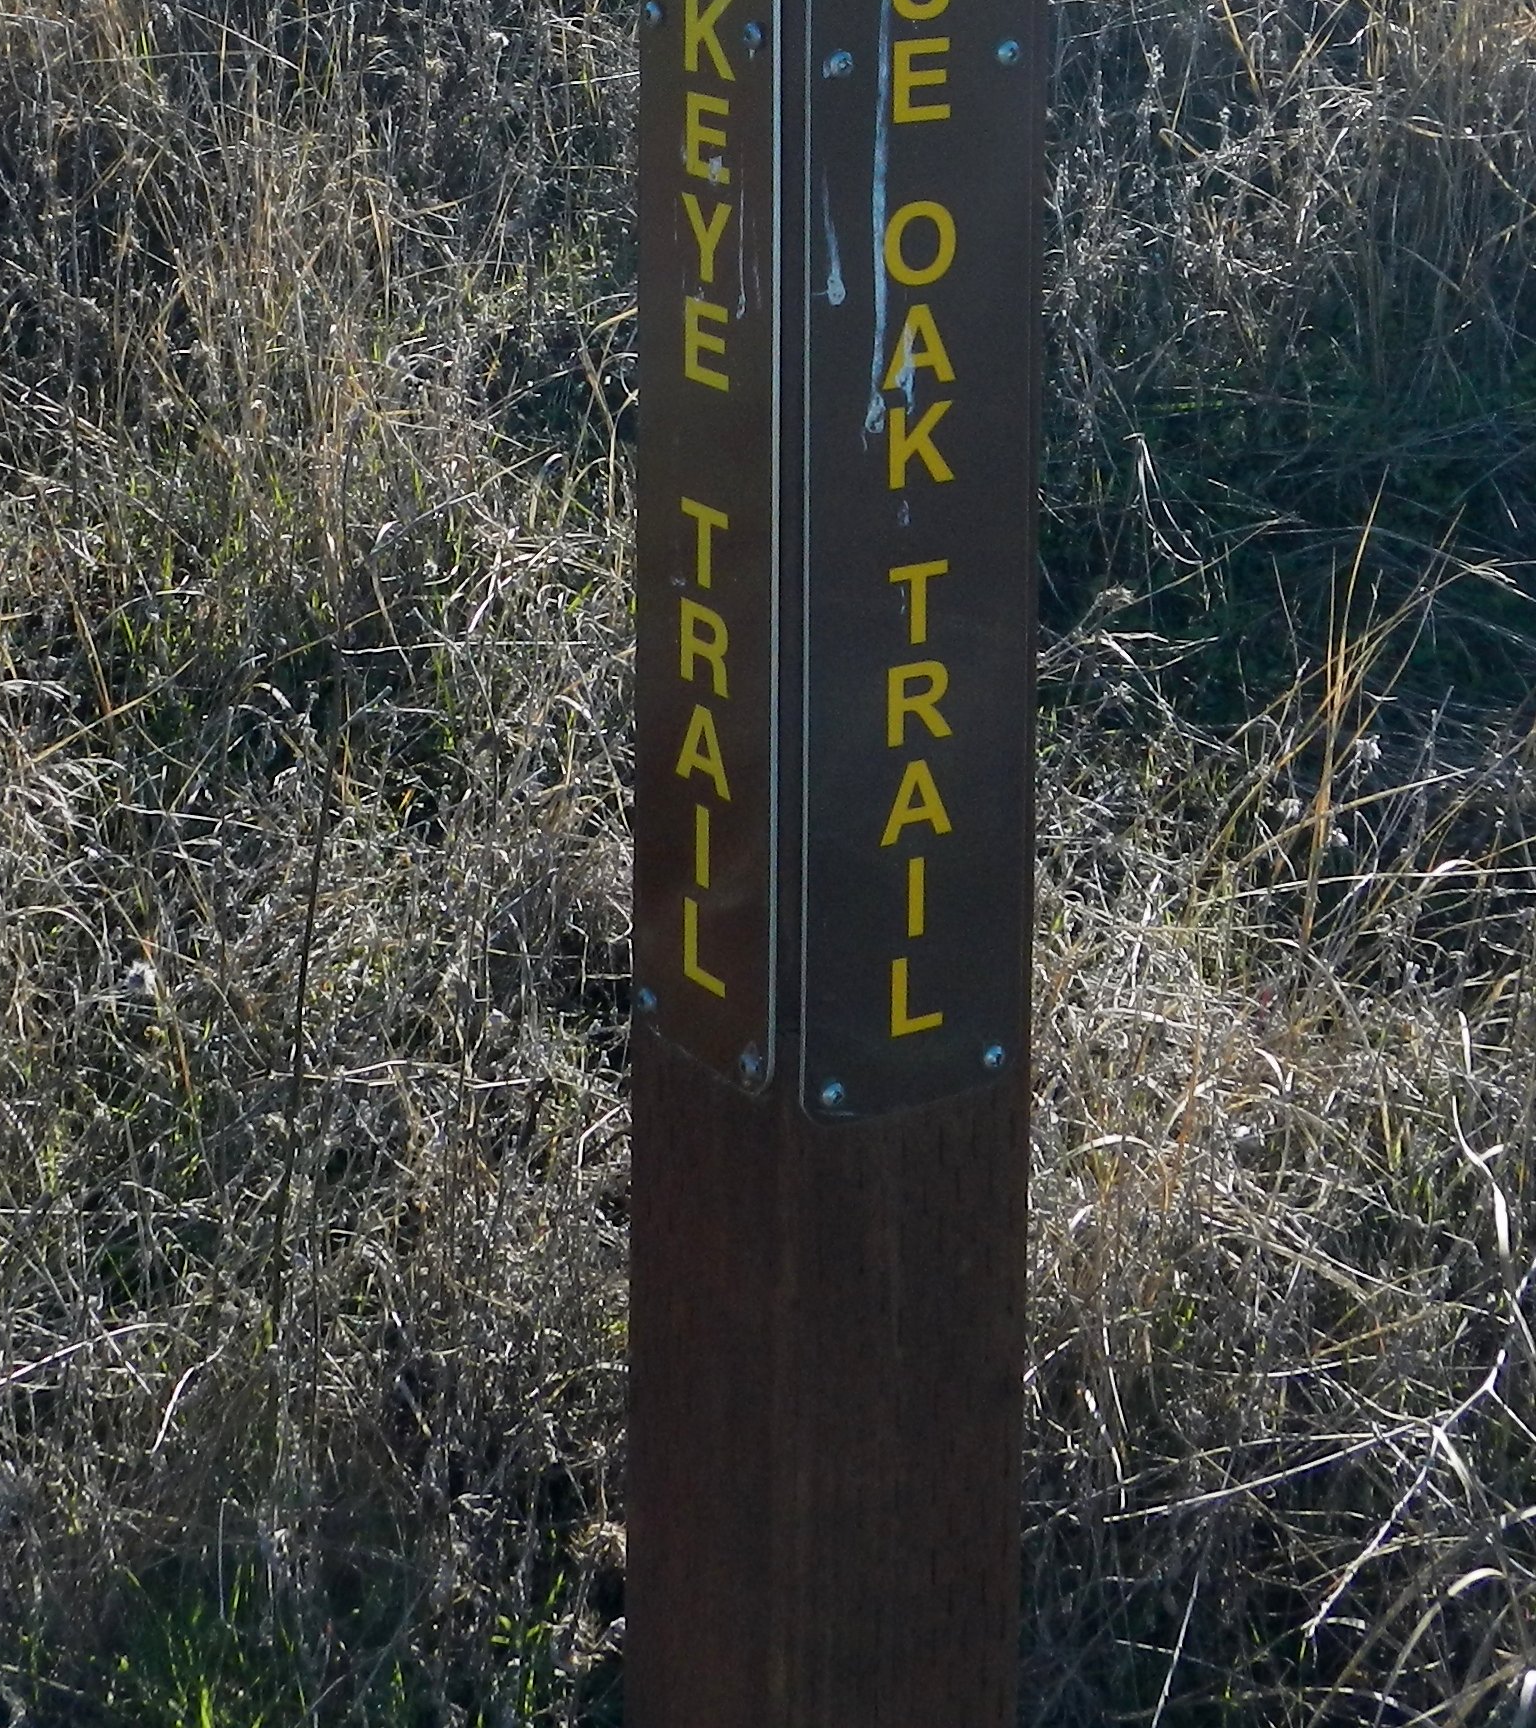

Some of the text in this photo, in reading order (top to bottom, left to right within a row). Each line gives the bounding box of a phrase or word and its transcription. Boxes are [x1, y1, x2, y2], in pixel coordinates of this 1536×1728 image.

[883, 200, 958, 490] OAK
[675, 497, 731, 999] TRAIL
[881, 559, 953, 1038] TRAIL
